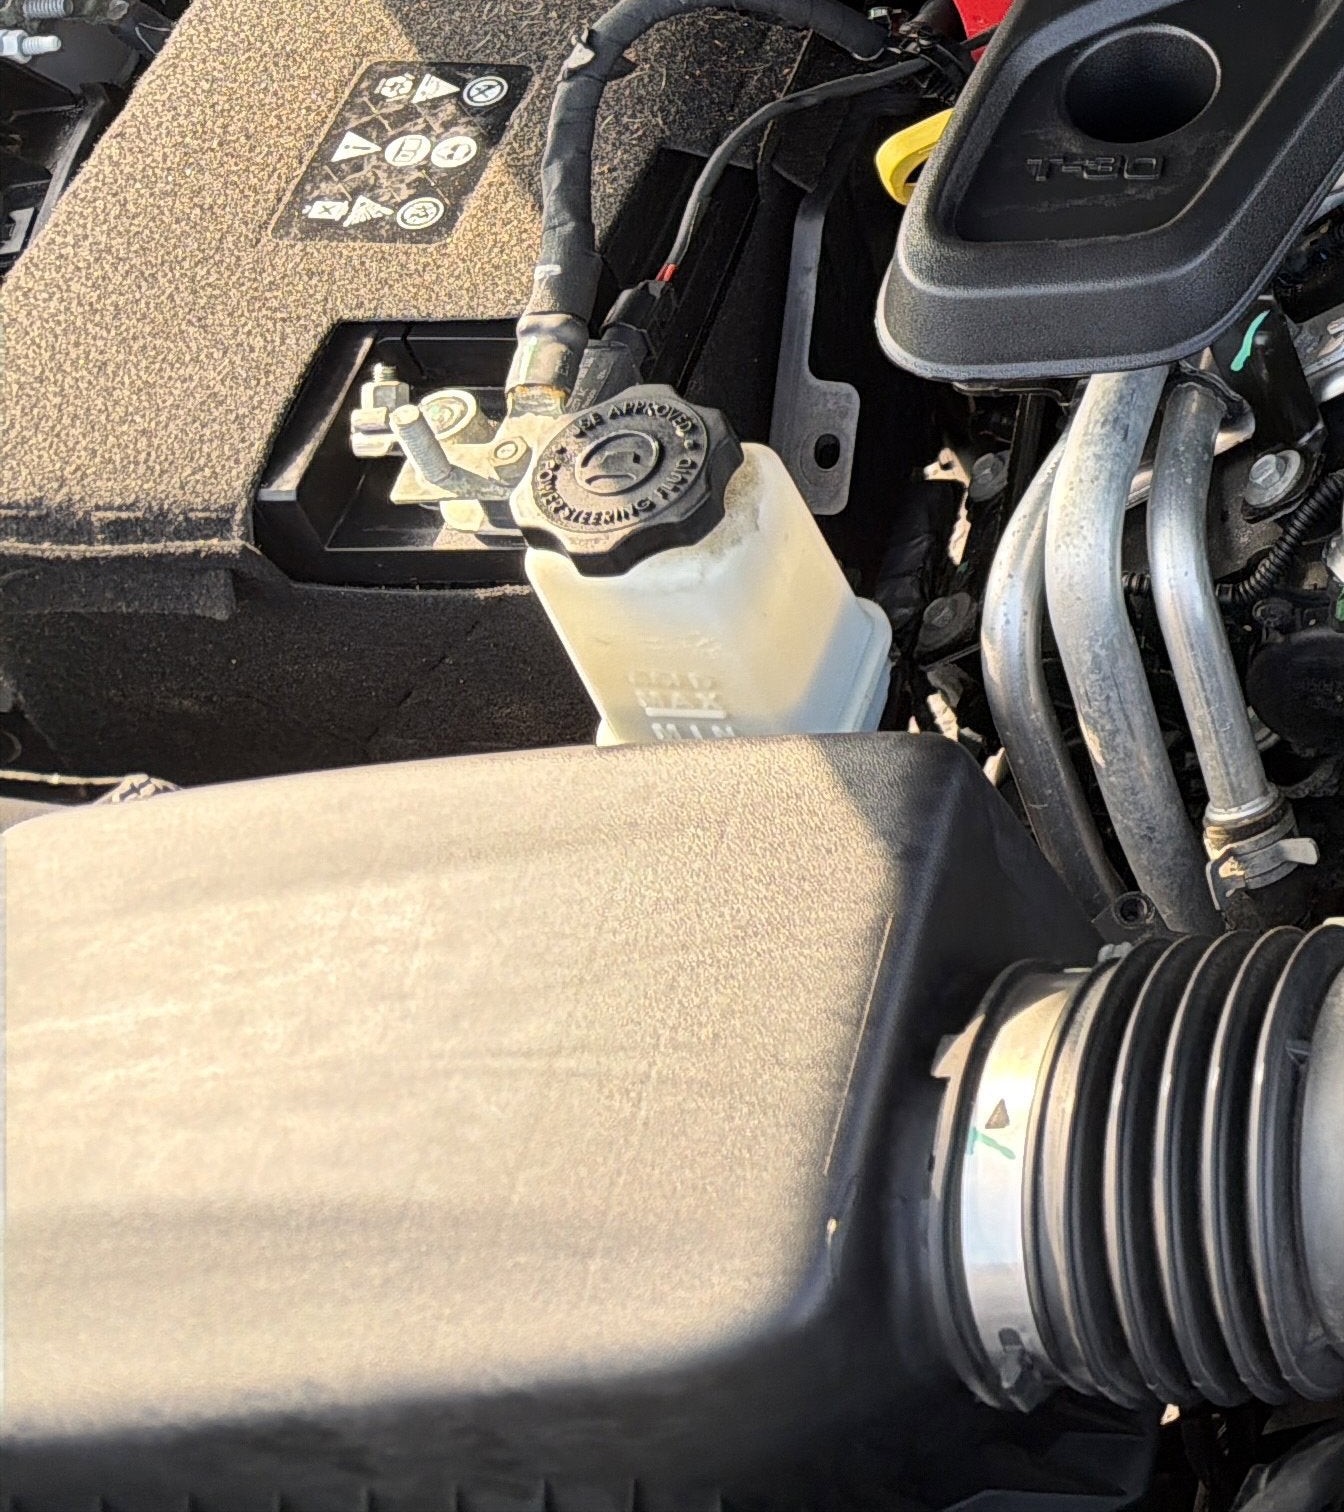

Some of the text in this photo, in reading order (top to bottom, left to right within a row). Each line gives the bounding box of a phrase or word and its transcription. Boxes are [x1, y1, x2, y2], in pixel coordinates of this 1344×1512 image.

[607, 400, 699, 434] APPROVED
[636, 689, 725, 710] MAX
[651, 722, 736, 741] MIN
